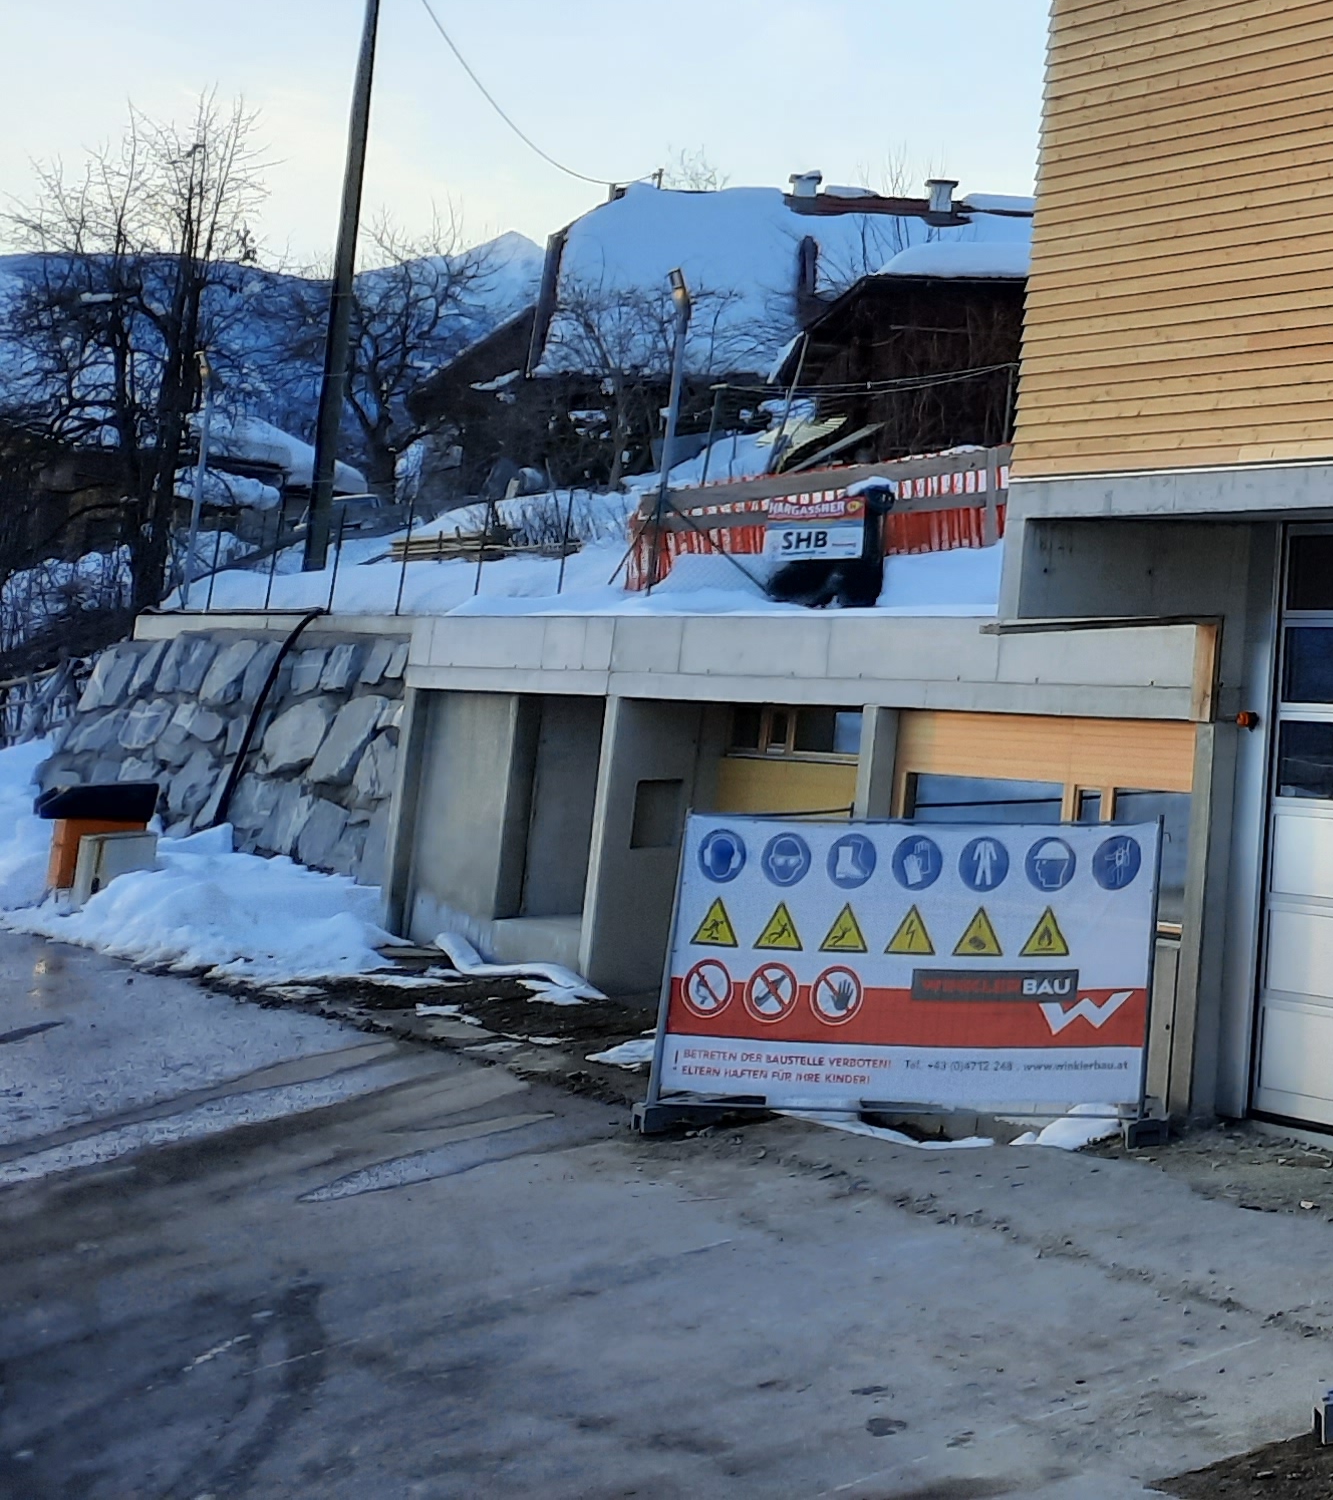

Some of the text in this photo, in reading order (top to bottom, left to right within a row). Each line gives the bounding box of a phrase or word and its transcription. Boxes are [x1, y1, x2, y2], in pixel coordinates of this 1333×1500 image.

[781, 530, 829, 551] SHB
[683, 1049, 891, 1069] BETRETEN DER BAUSTELLE VERBOTEN!
[1023, 1060, 1128, 1071] www.winklerbau.at
[682, 1066, 870, 1085] ELTERN HAFTEN FÜR IHRE KINDER!
